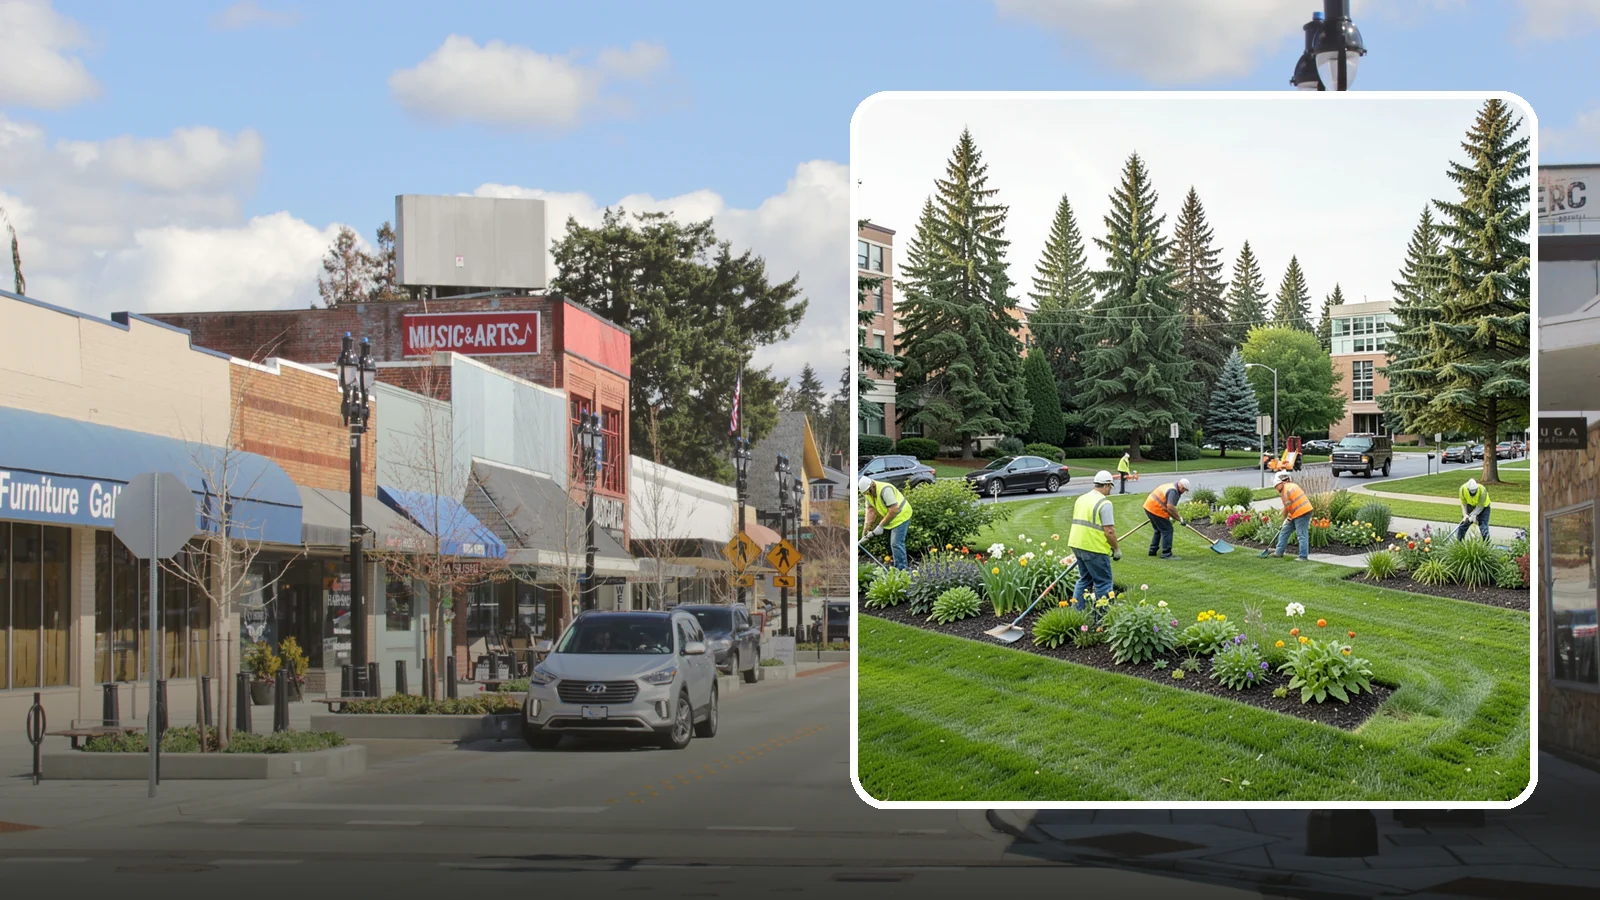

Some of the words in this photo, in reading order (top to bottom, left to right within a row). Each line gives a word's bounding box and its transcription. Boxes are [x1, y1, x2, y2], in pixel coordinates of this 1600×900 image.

[0, 472, 79, 515] Furniture
[89, 482, 122, 519] Gal
[453, 563, 479, 574] SUSHI
